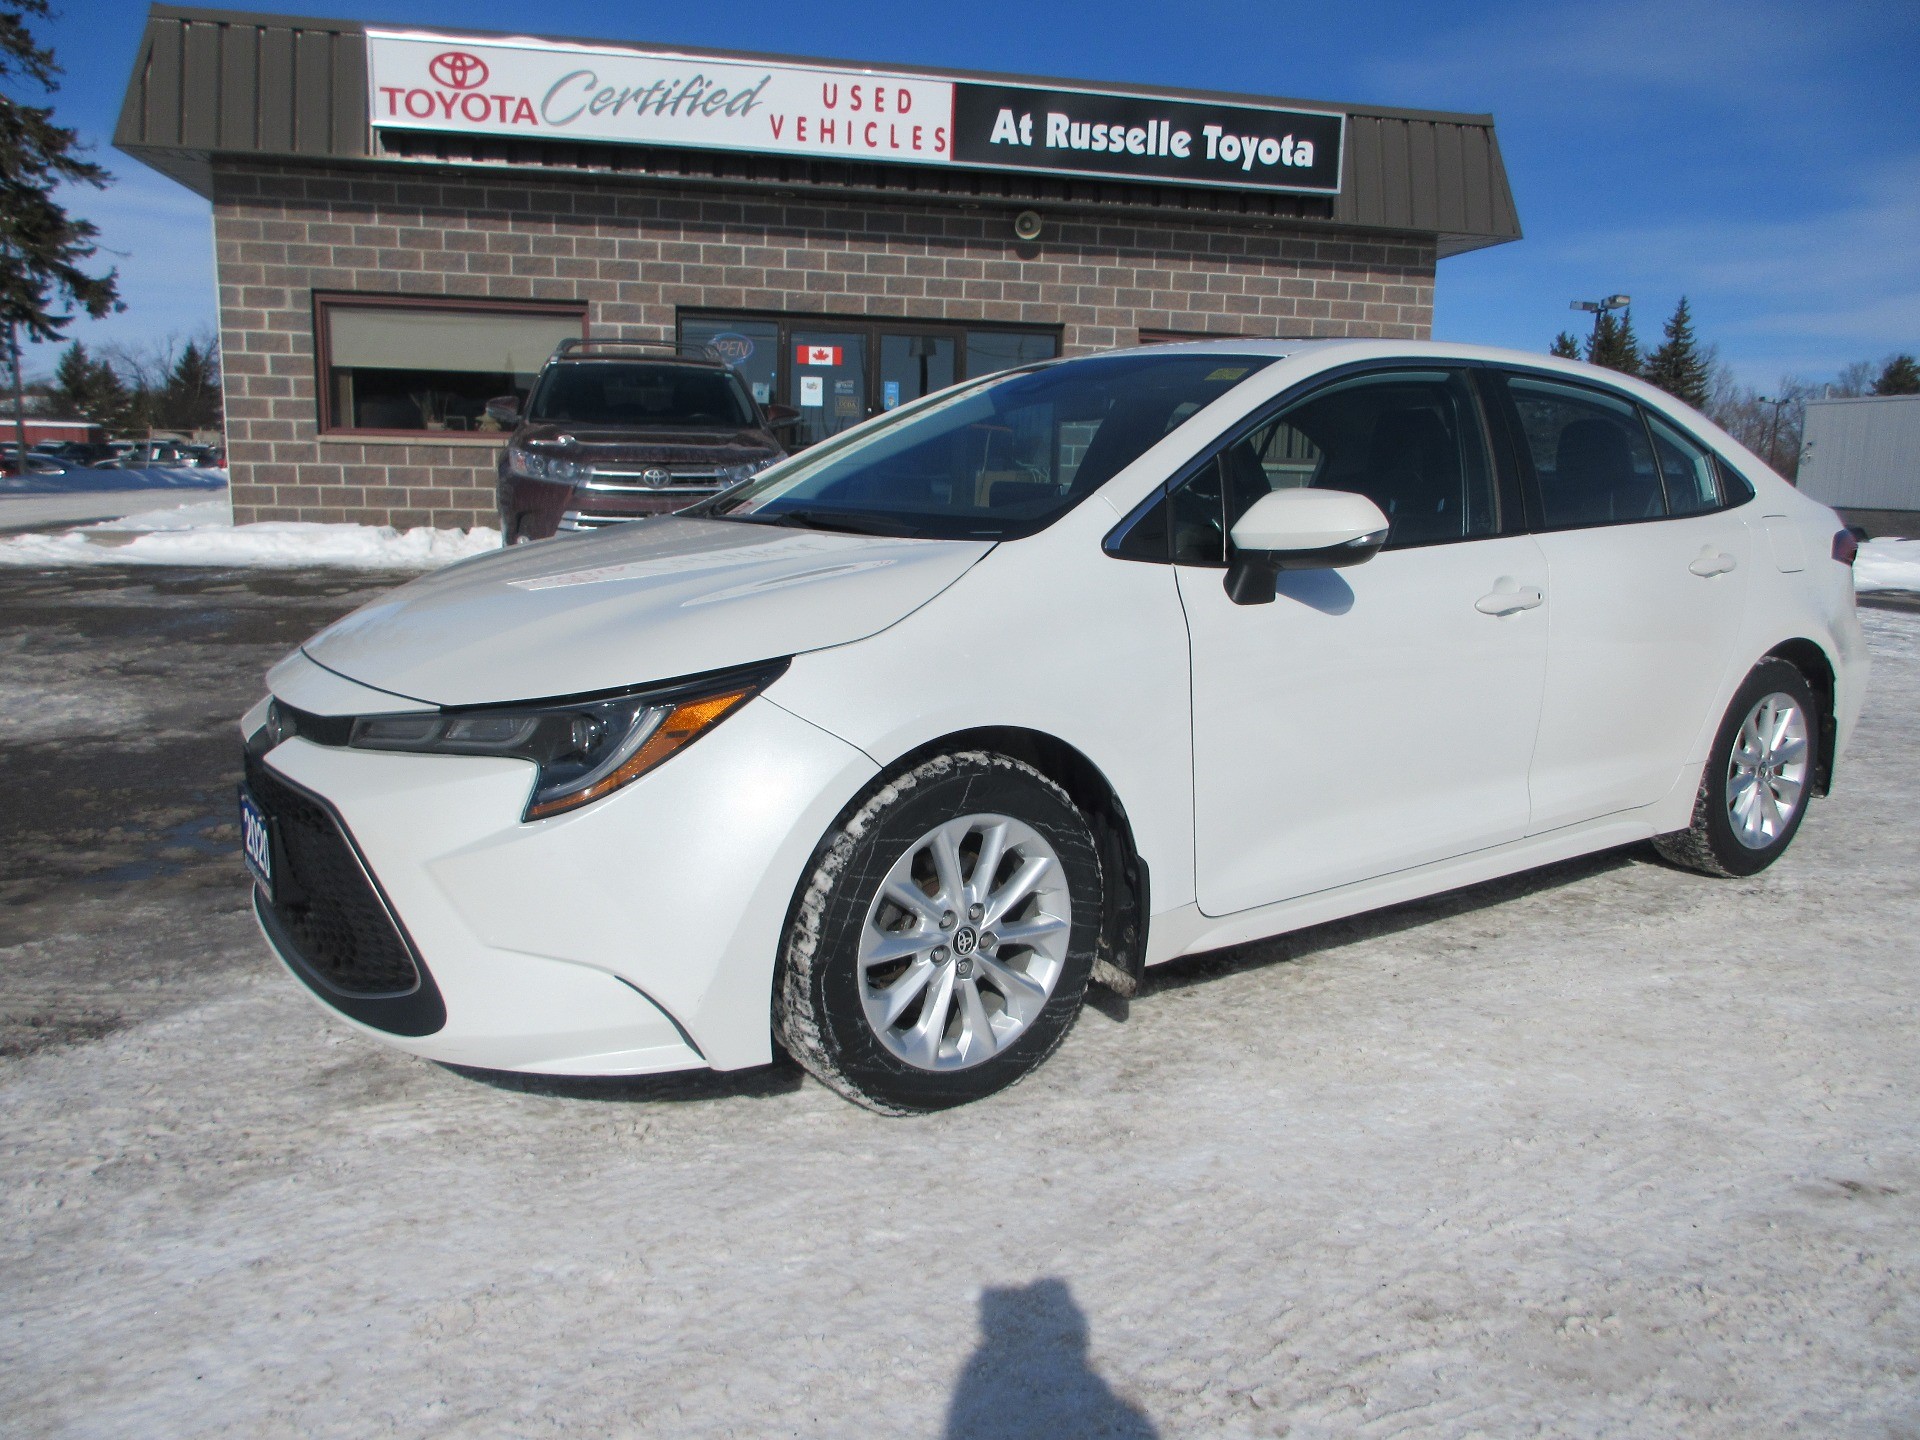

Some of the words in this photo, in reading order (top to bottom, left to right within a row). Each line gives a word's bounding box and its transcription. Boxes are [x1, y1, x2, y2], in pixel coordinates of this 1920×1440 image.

[380, 86, 539, 125] TOYOTA
[541, 70, 771, 127] Certified
[822, 83, 912, 114] USED
[770, 114, 947, 152] VEHICLES
[989, 108, 1034, 146] At
[1045, 112, 1192, 159] Russelle
[1202, 124, 1315, 171] Toyota
[708, 340, 749, 357] OPEN
